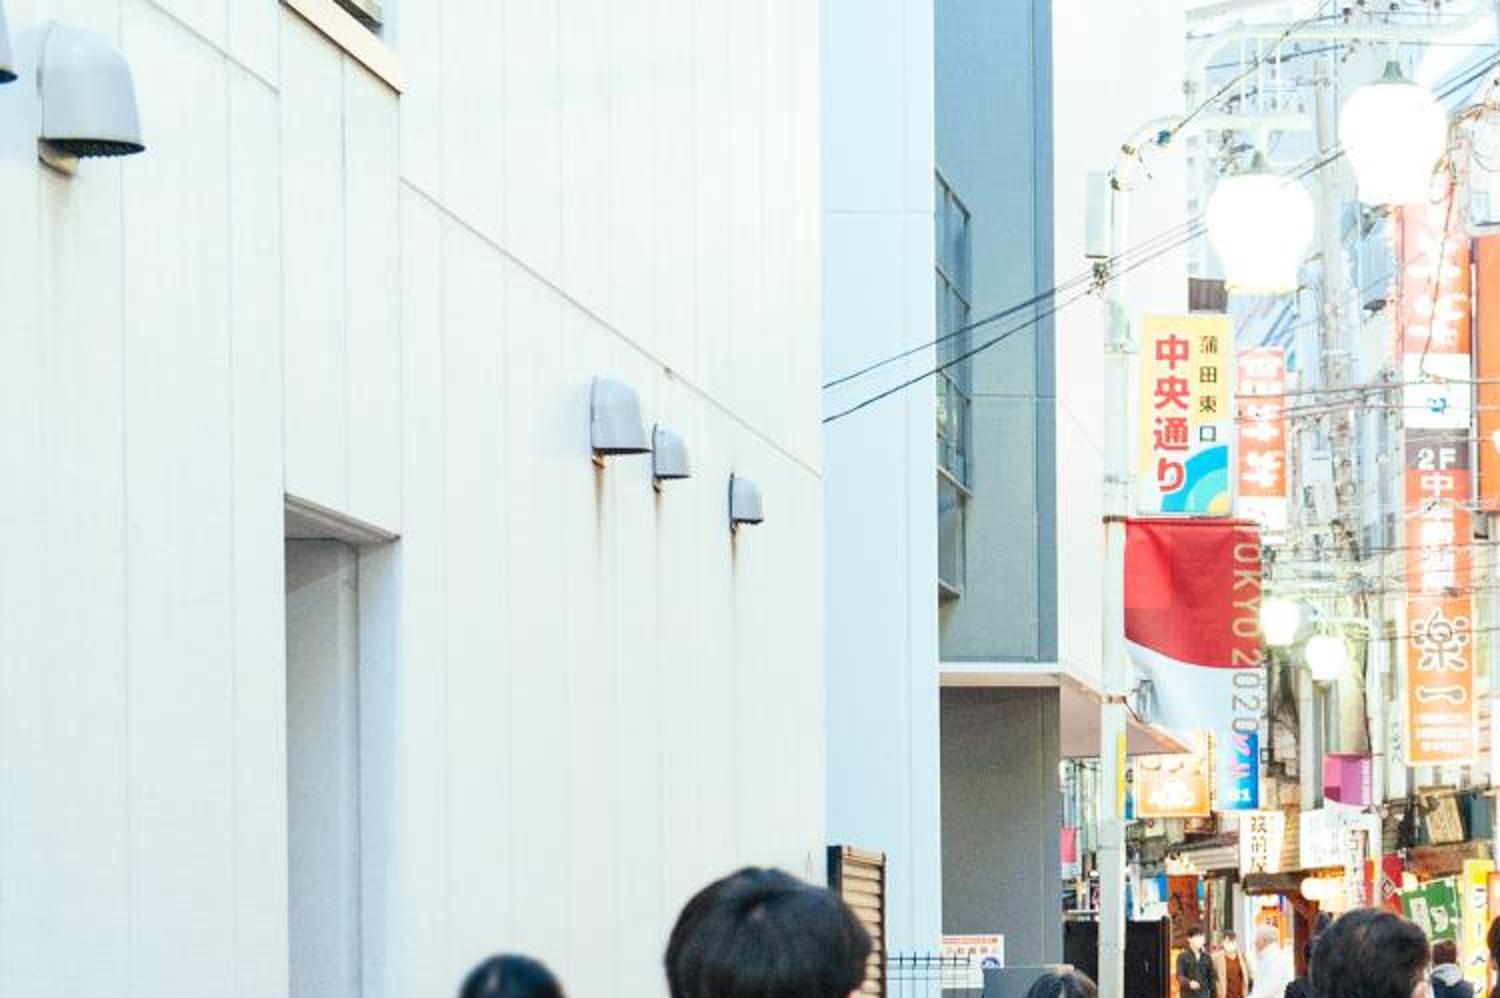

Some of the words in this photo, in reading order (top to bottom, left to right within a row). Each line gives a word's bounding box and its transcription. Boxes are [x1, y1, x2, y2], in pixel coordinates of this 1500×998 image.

[1154, 333, 1191, 493] 中央通り
[1199, 335, 1218, 443] 蒲田東口
[1418, 448, 1456, 470] 2F
[1231, 648, 1266, 734] 2020
